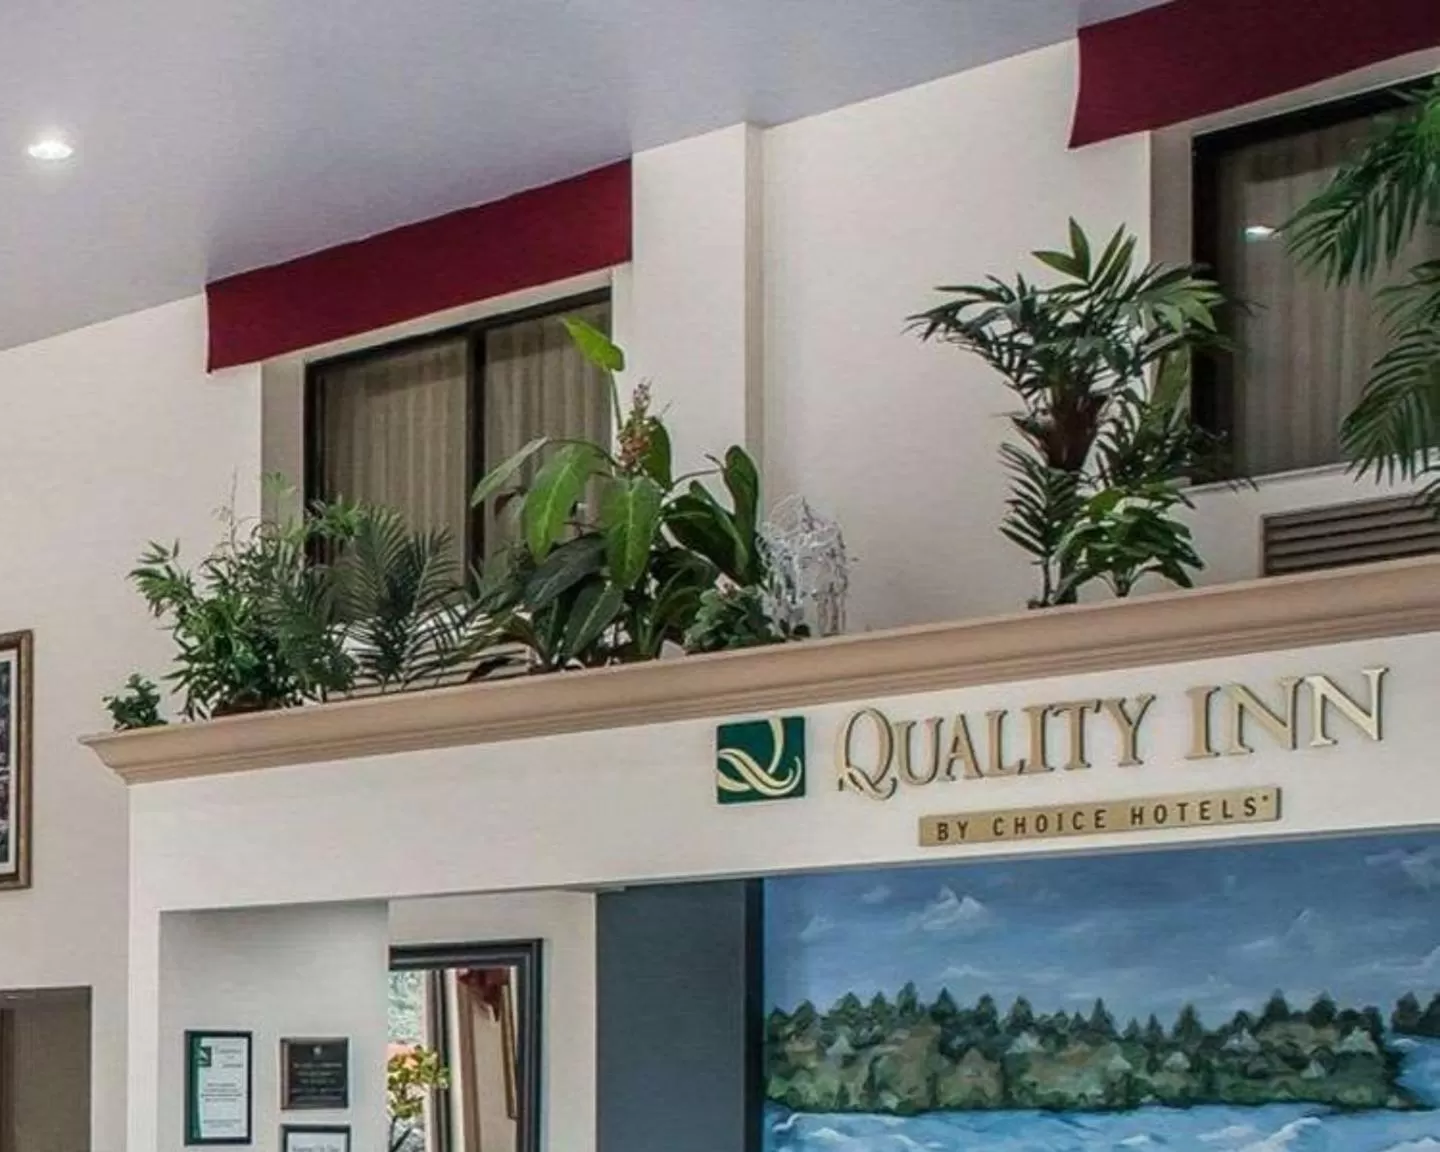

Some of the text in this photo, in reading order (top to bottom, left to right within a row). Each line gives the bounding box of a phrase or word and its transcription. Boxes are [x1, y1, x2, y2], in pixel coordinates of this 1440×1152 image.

[835, 666, 1390, 801] QUALITY INN
[937, 820, 969, 842] BY
[992, 809, 1107, 837] CHOICE
